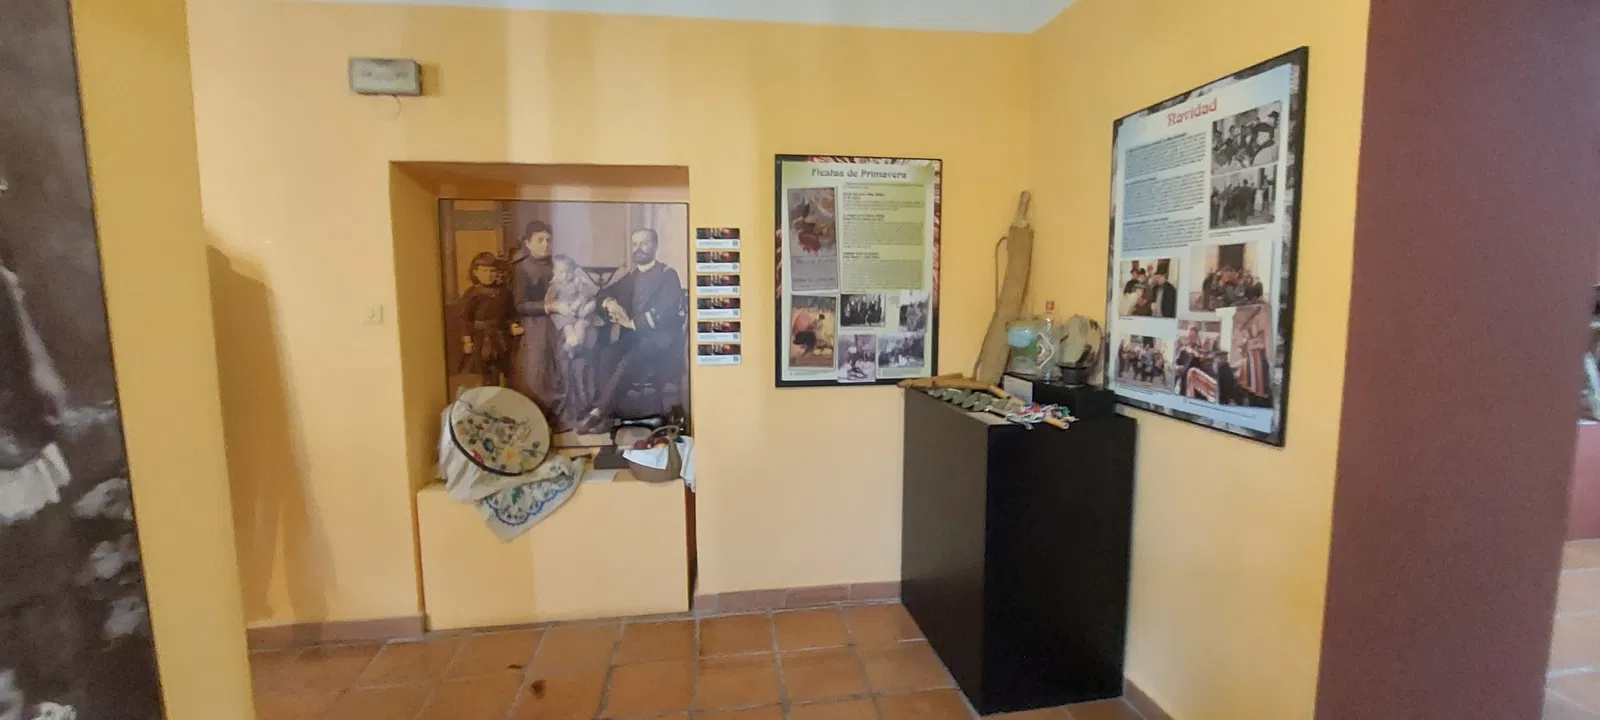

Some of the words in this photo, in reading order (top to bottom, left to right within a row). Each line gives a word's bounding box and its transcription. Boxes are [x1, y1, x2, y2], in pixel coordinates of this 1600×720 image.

[1167, 98, 1217, 126] Navidad
[811, 168, 844, 177] Fiestas
[847, 168, 859, 178] de
[861, 169, 907, 179] Primavera
